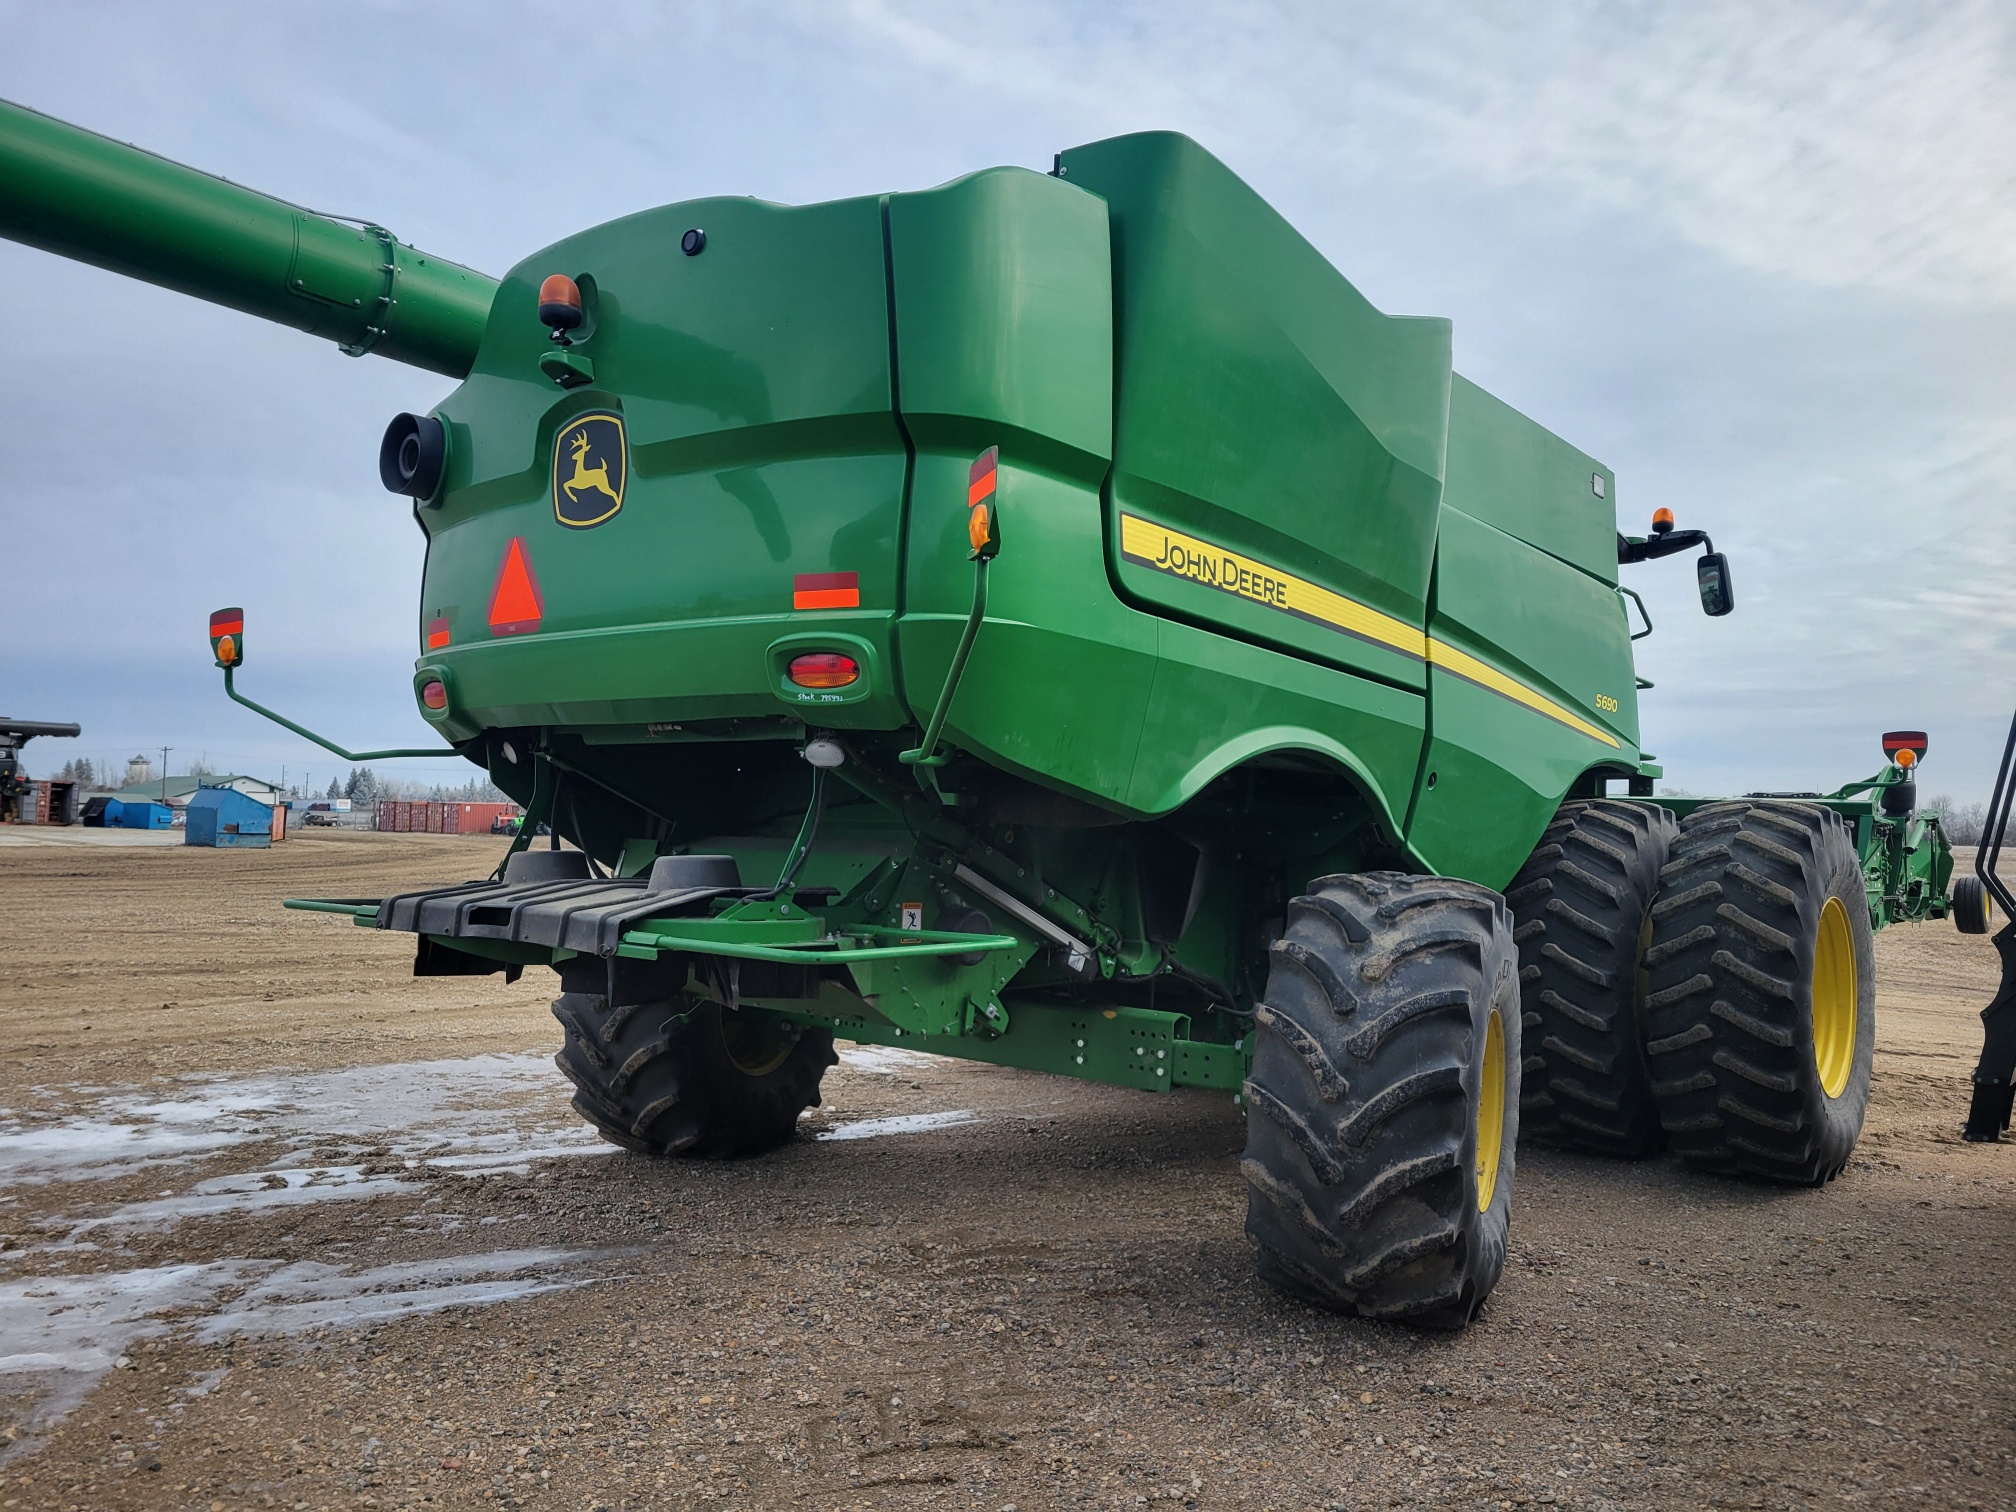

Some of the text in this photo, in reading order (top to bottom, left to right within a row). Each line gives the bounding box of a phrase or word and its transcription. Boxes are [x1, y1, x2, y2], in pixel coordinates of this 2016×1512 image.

[1155, 536, 1287, 606] JOHN DEERE
[1595, 693, 1618, 713] S690
